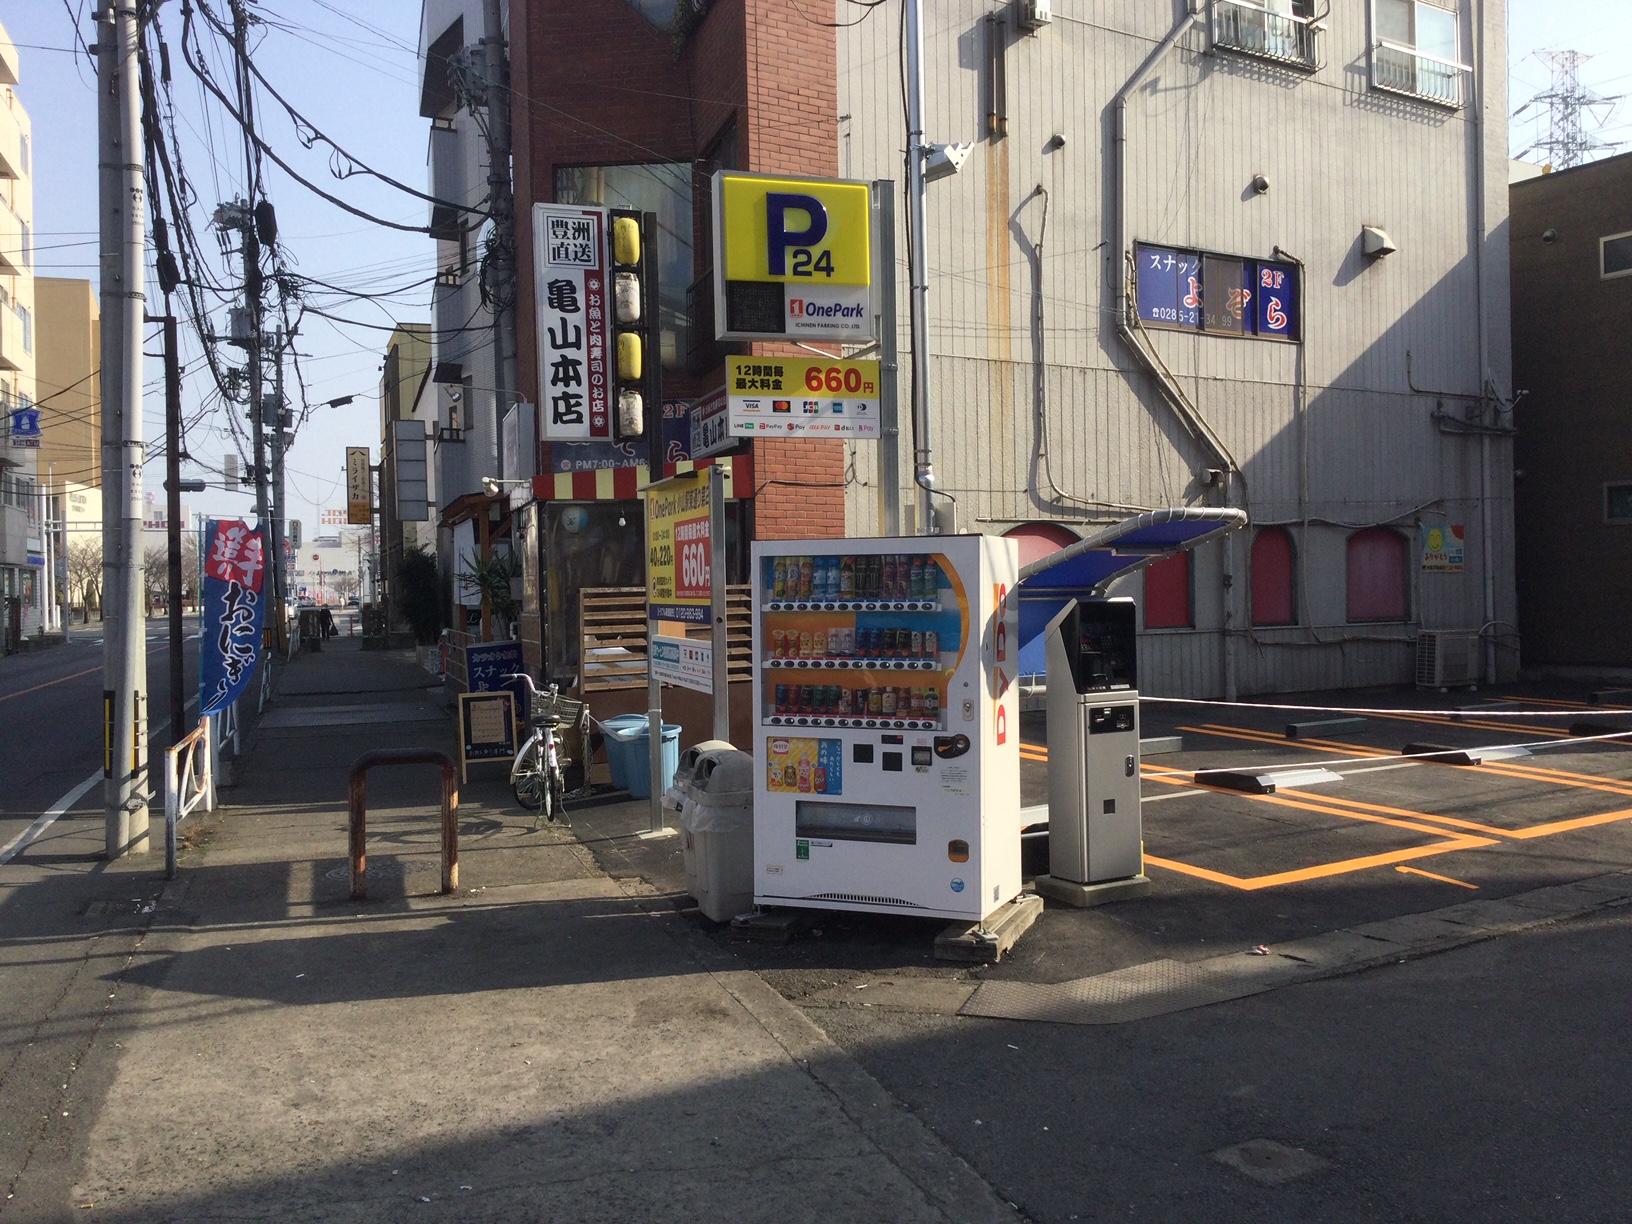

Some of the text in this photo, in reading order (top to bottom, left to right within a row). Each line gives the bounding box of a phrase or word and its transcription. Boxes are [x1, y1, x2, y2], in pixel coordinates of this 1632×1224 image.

[550, 219, 591, 242] 豊洲
[765, 191, 829, 276] P
[551, 241, 592, 263] 直送
[791, 248, 836, 278] 24
[1260, 268, 1285, 289] 2F
[805, 302, 864, 318] OnePark
[546, 278, 584, 426] 亀山本店
[735, 364, 784, 377] 12時間毎
[735, 377, 783, 390] 最大料金
[201, 579, 258, 713] おにぎり
